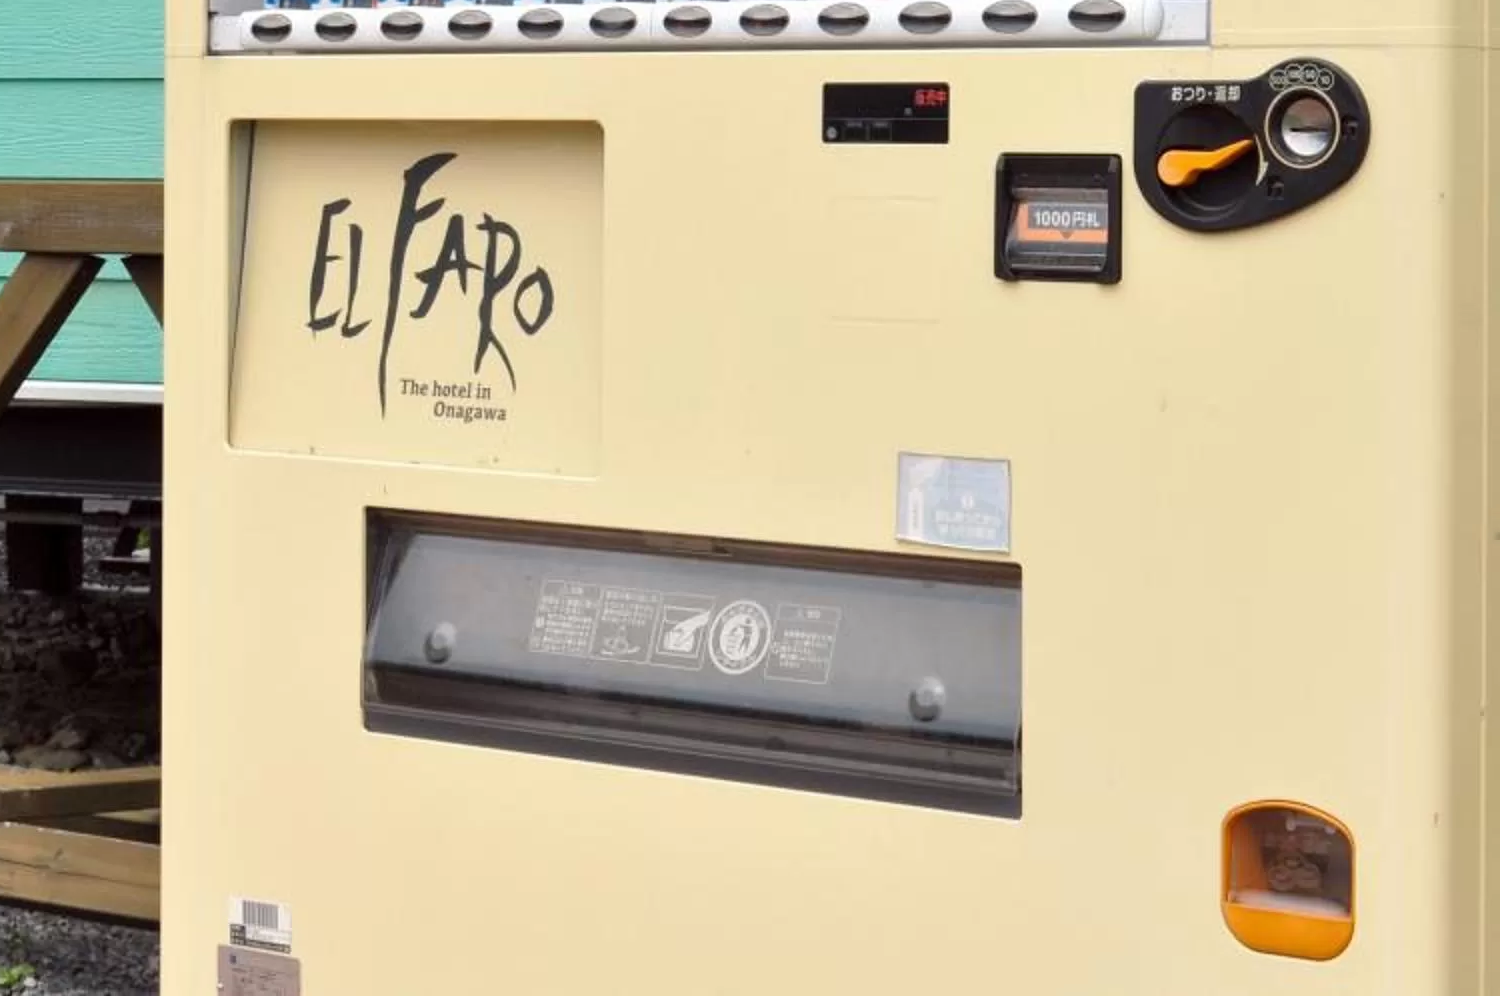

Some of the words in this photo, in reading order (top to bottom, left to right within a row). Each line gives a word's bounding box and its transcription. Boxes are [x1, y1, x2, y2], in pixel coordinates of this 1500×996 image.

[1171, 86, 1242, 102] おつり・返却
[1034, 211, 1100, 227] 1000円札
[305, 198, 372, 338] EL
[400, 378, 429, 396] The
[432, 381, 472, 399] hotel
[475, 383, 491, 400] in
[433, 401, 507, 423] Onagawa
